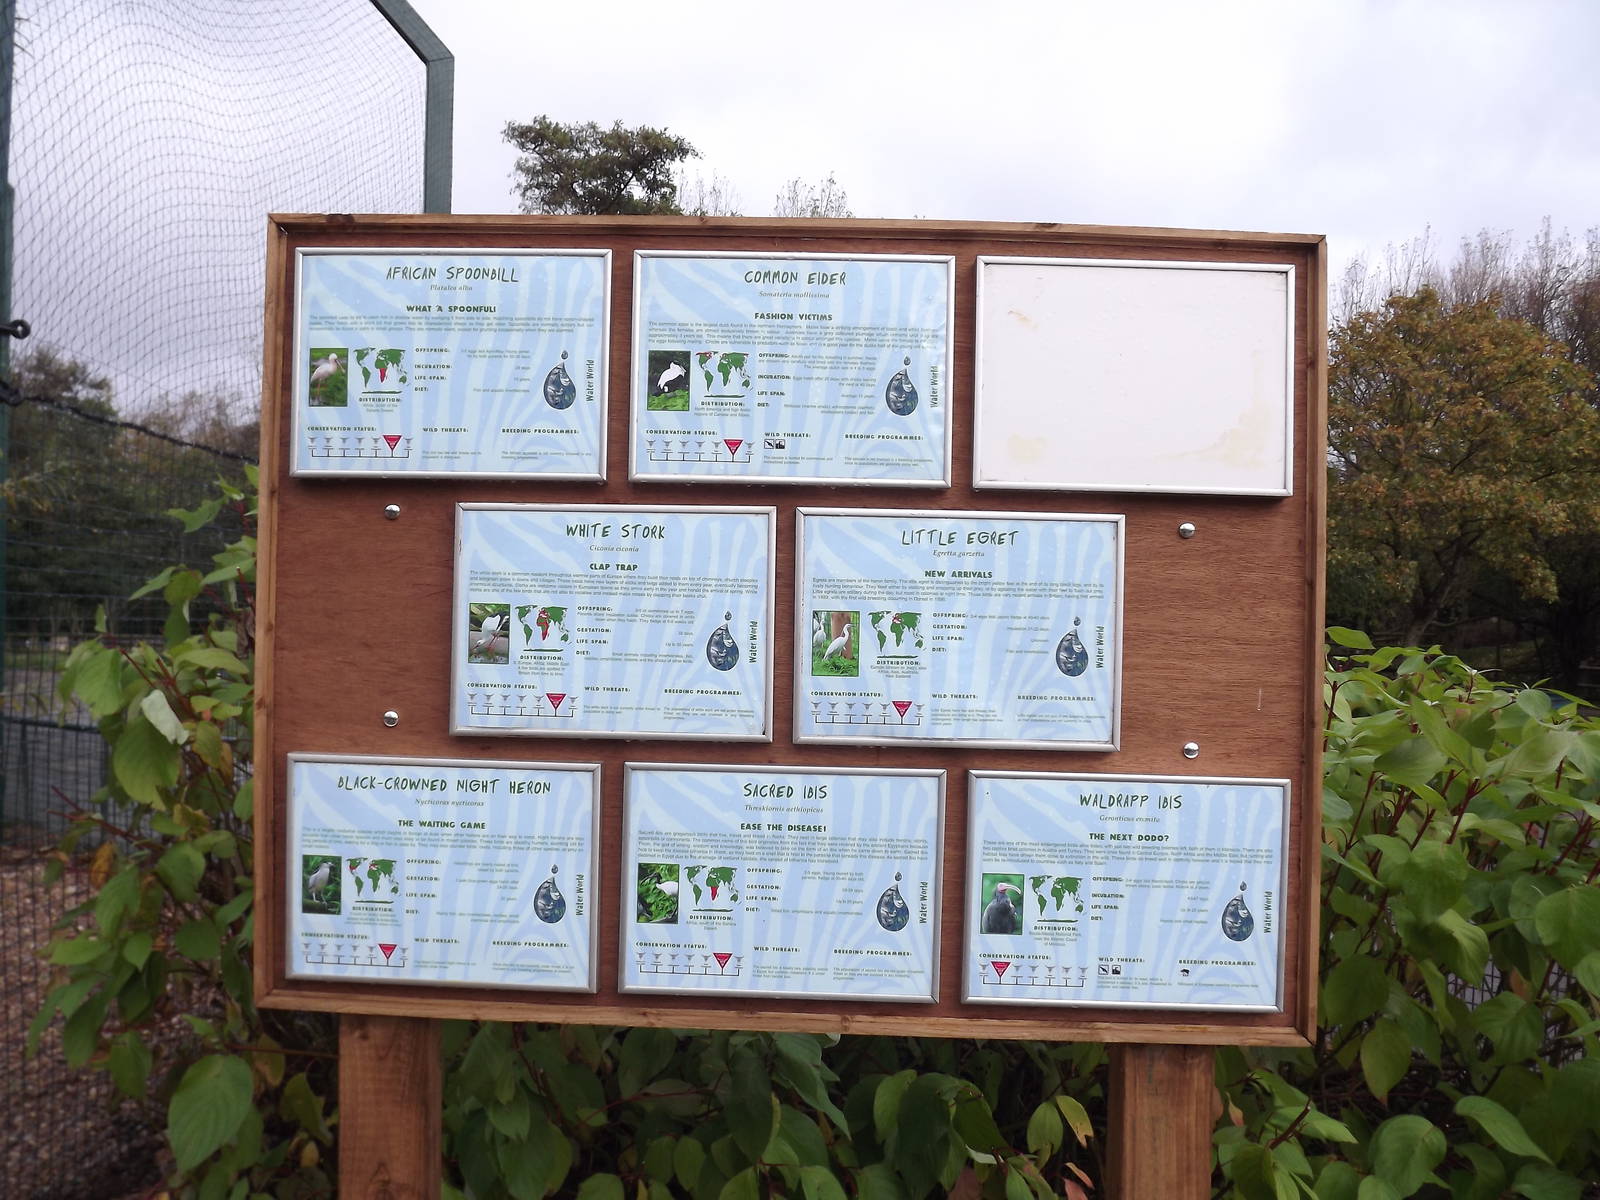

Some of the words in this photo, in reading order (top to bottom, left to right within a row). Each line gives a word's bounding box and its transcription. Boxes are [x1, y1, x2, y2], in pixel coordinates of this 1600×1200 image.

[386, 266, 436, 280] AFRICAN
[446, 267, 519, 282] SPOONBILL
[744, 270, 798, 284] COMMON
[807, 272, 846, 285] EIDER
[586, 359, 594, 381] World
[586, 383, 594, 402] Water
[566, 523, 611, 538] WHITE
[621, 524, 665, 539] STORK
[902, 529, 957, 546] LITTLE
[967, 531, 1018, 546] EGRET
[749, 620, 758, 642] World
[1096, 626, 1104, 647] World
[749, 643, 757, 665] Water
[1096, 648, 1104, 669] Water
[338, 776, 447, 791] BLACK-CROWNED
[457, 779, 500, 794] NIGHT
[509, 780, 551, 794] HERON
[744, 783, 793, 798] SACRED
[803, 785, 827, 799] IBIS
[1080, 793, 1148, 809] WALDRAPP
[1158, 795, 1182, 809] IBIS
[419, 820, 456, 828] WAITING
[460, 821, 486, 829] GAME
[576, 874, 584, 895] World
[920, 881, 928, 902] World
[576, 896, 584, 916] Water
[1264, 891, 1272, 912] World
[919, 903, 928, 924] Water
[1264, 914, 1272, 934] Water
